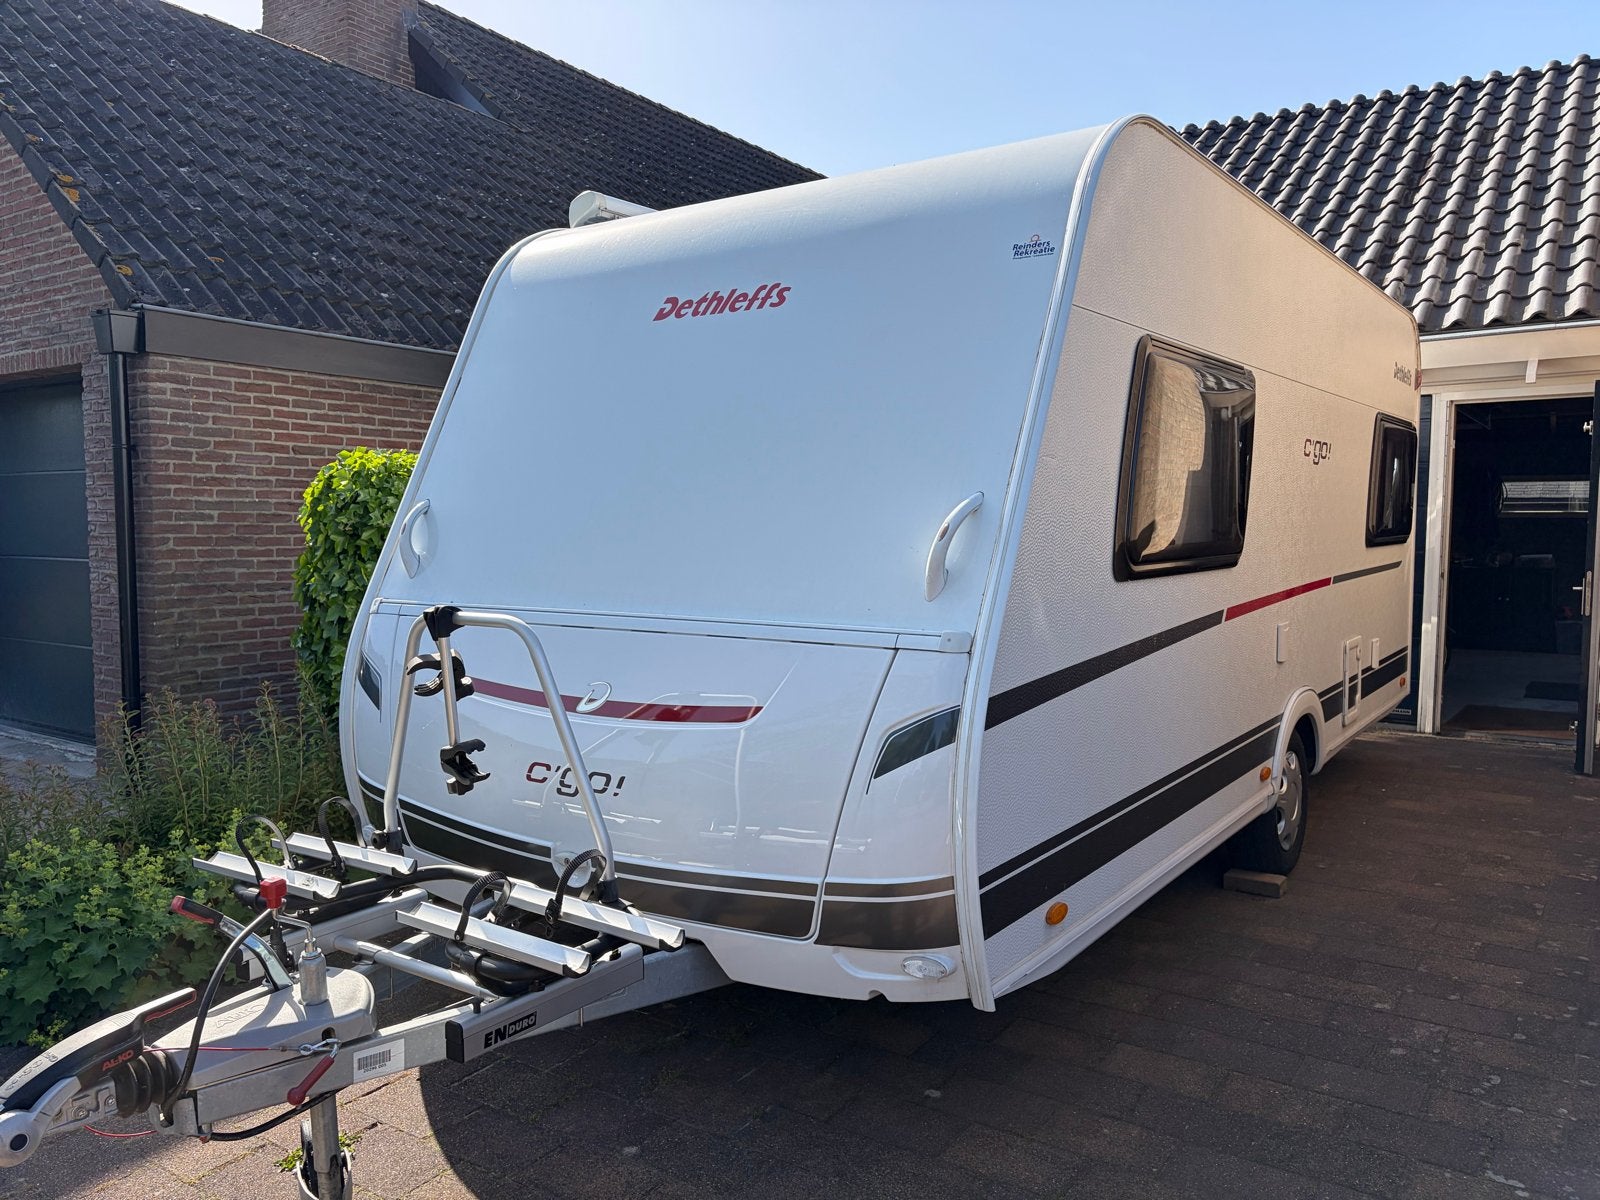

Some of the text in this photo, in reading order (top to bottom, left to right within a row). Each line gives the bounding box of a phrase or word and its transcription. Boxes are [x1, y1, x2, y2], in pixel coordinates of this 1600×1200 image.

[1012, 240, 1051, 251] Reinders
[1013, 246, 1055, 257] Rekreatie
[652, 282, 792, 322] Dethleffs
[483, 1010, 538, 1049] ENDURO
